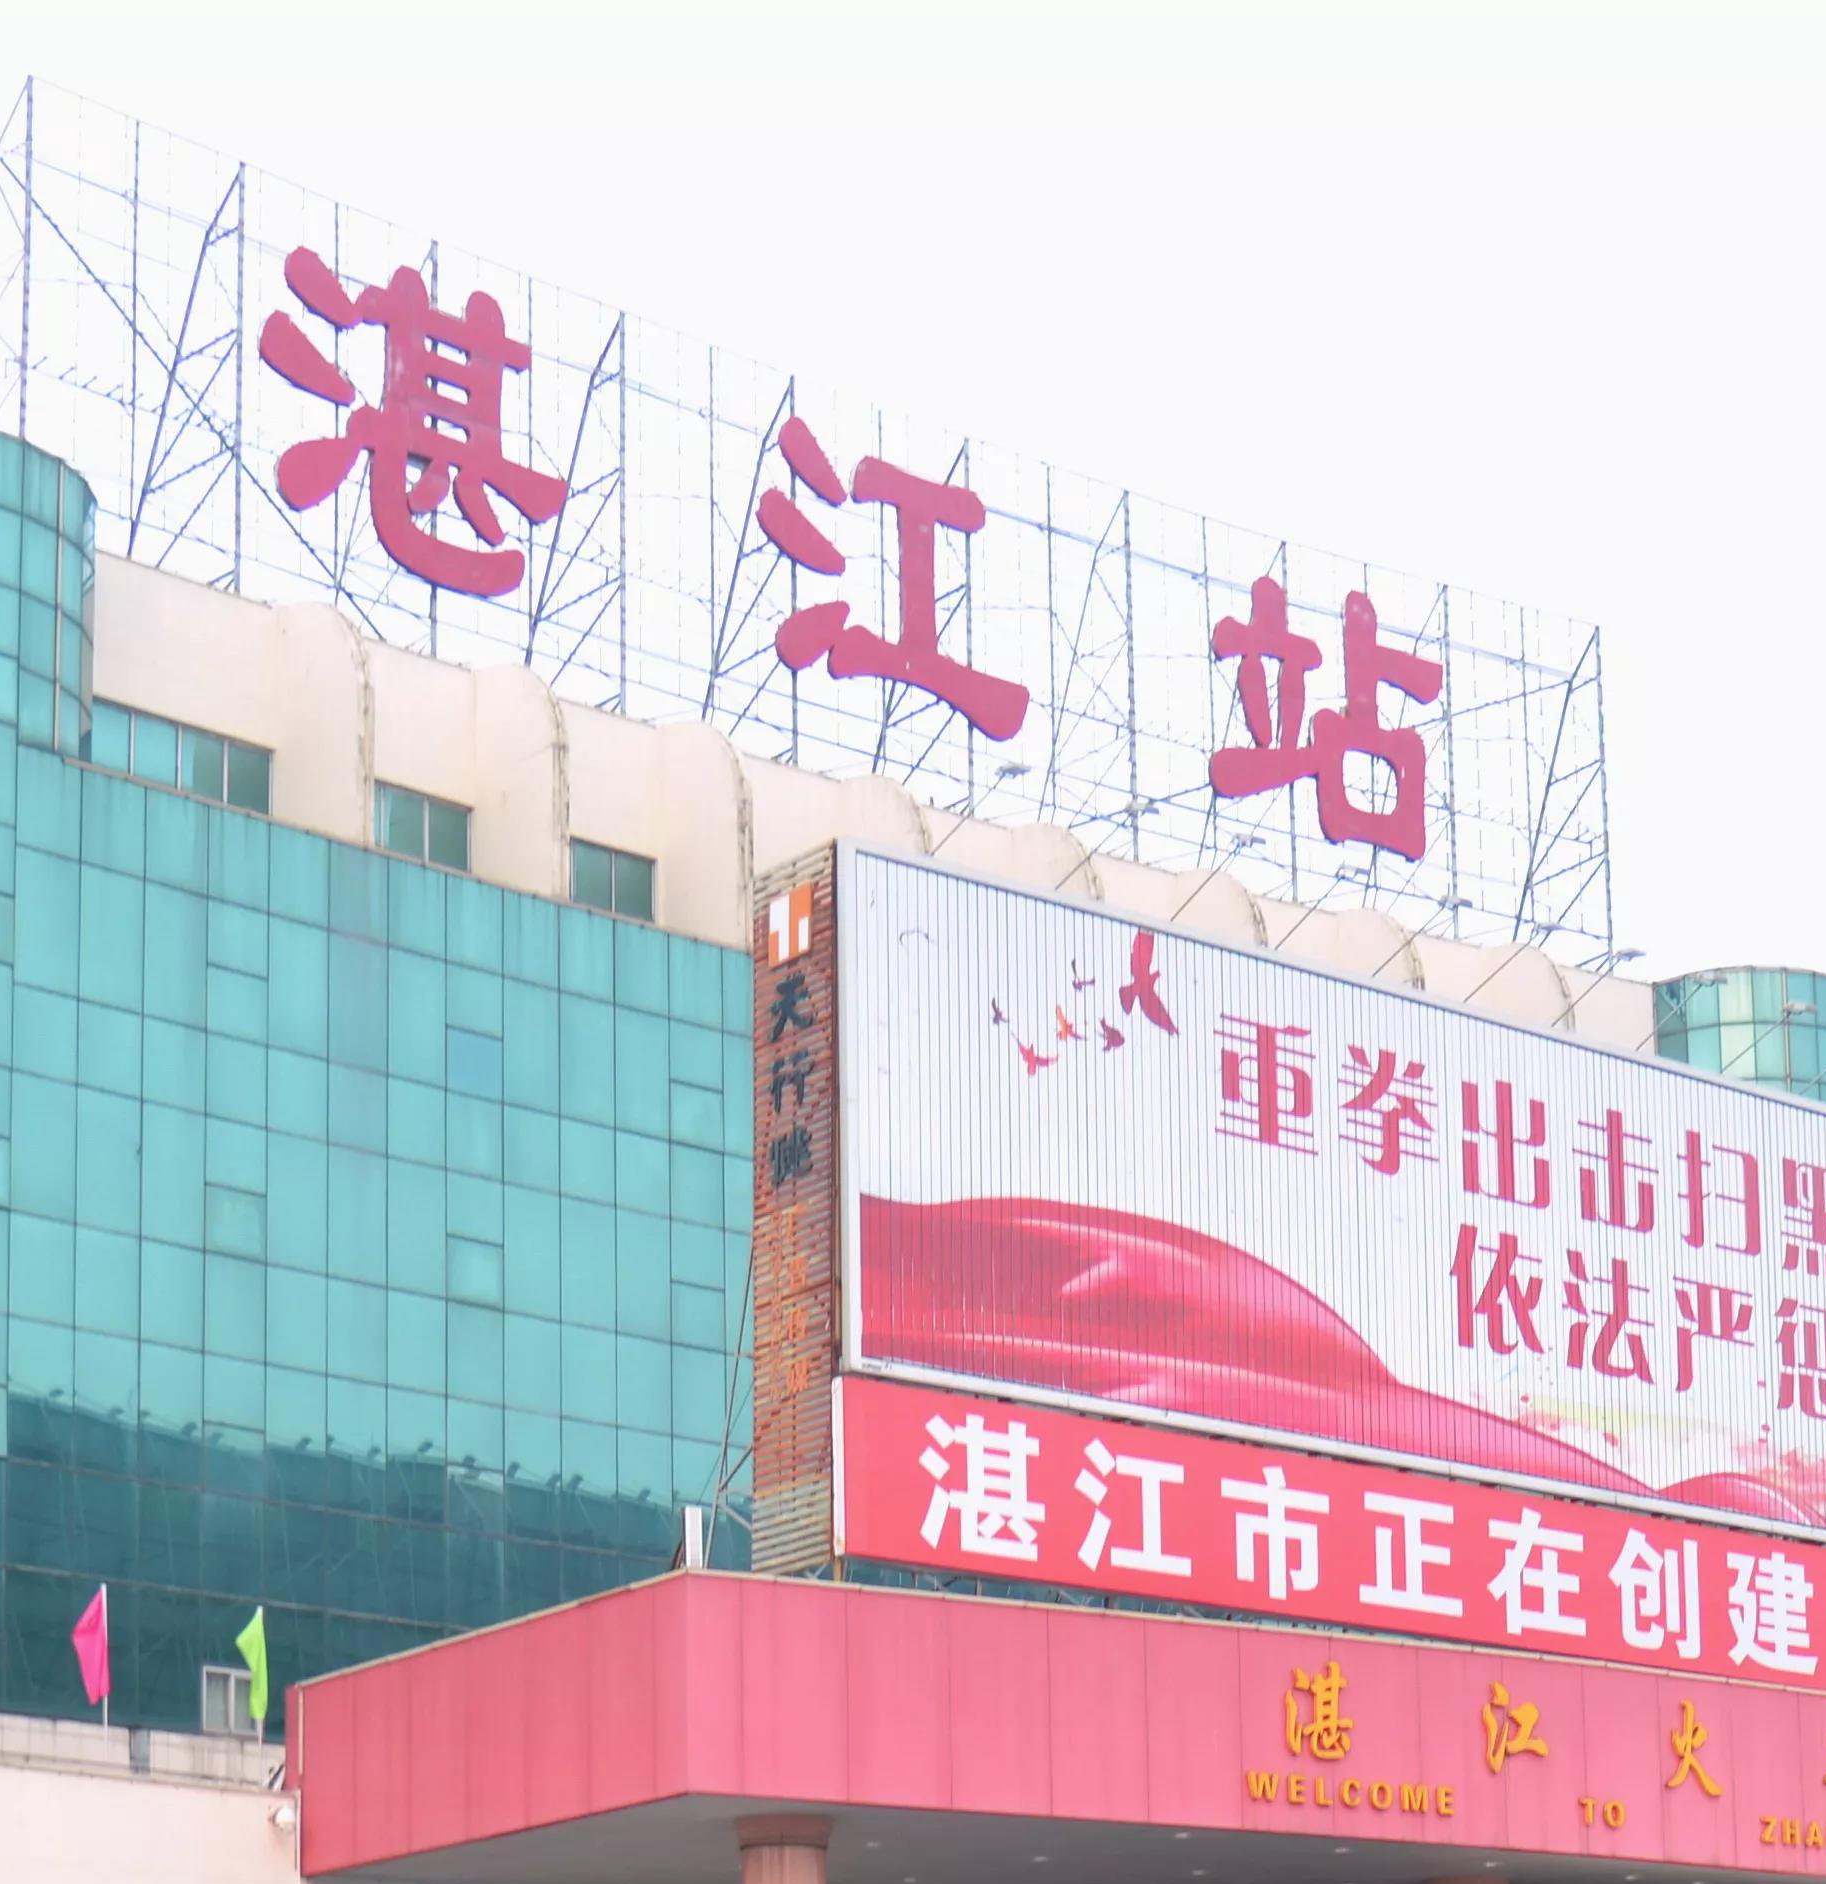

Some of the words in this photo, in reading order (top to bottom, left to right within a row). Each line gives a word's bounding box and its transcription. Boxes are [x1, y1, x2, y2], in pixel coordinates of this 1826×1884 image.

[258, 246, 1444, 862] 湛江站
[1247, 1769, 1456, 1817] WELCOME
[1579, 1797, 1627, 1829] TO
